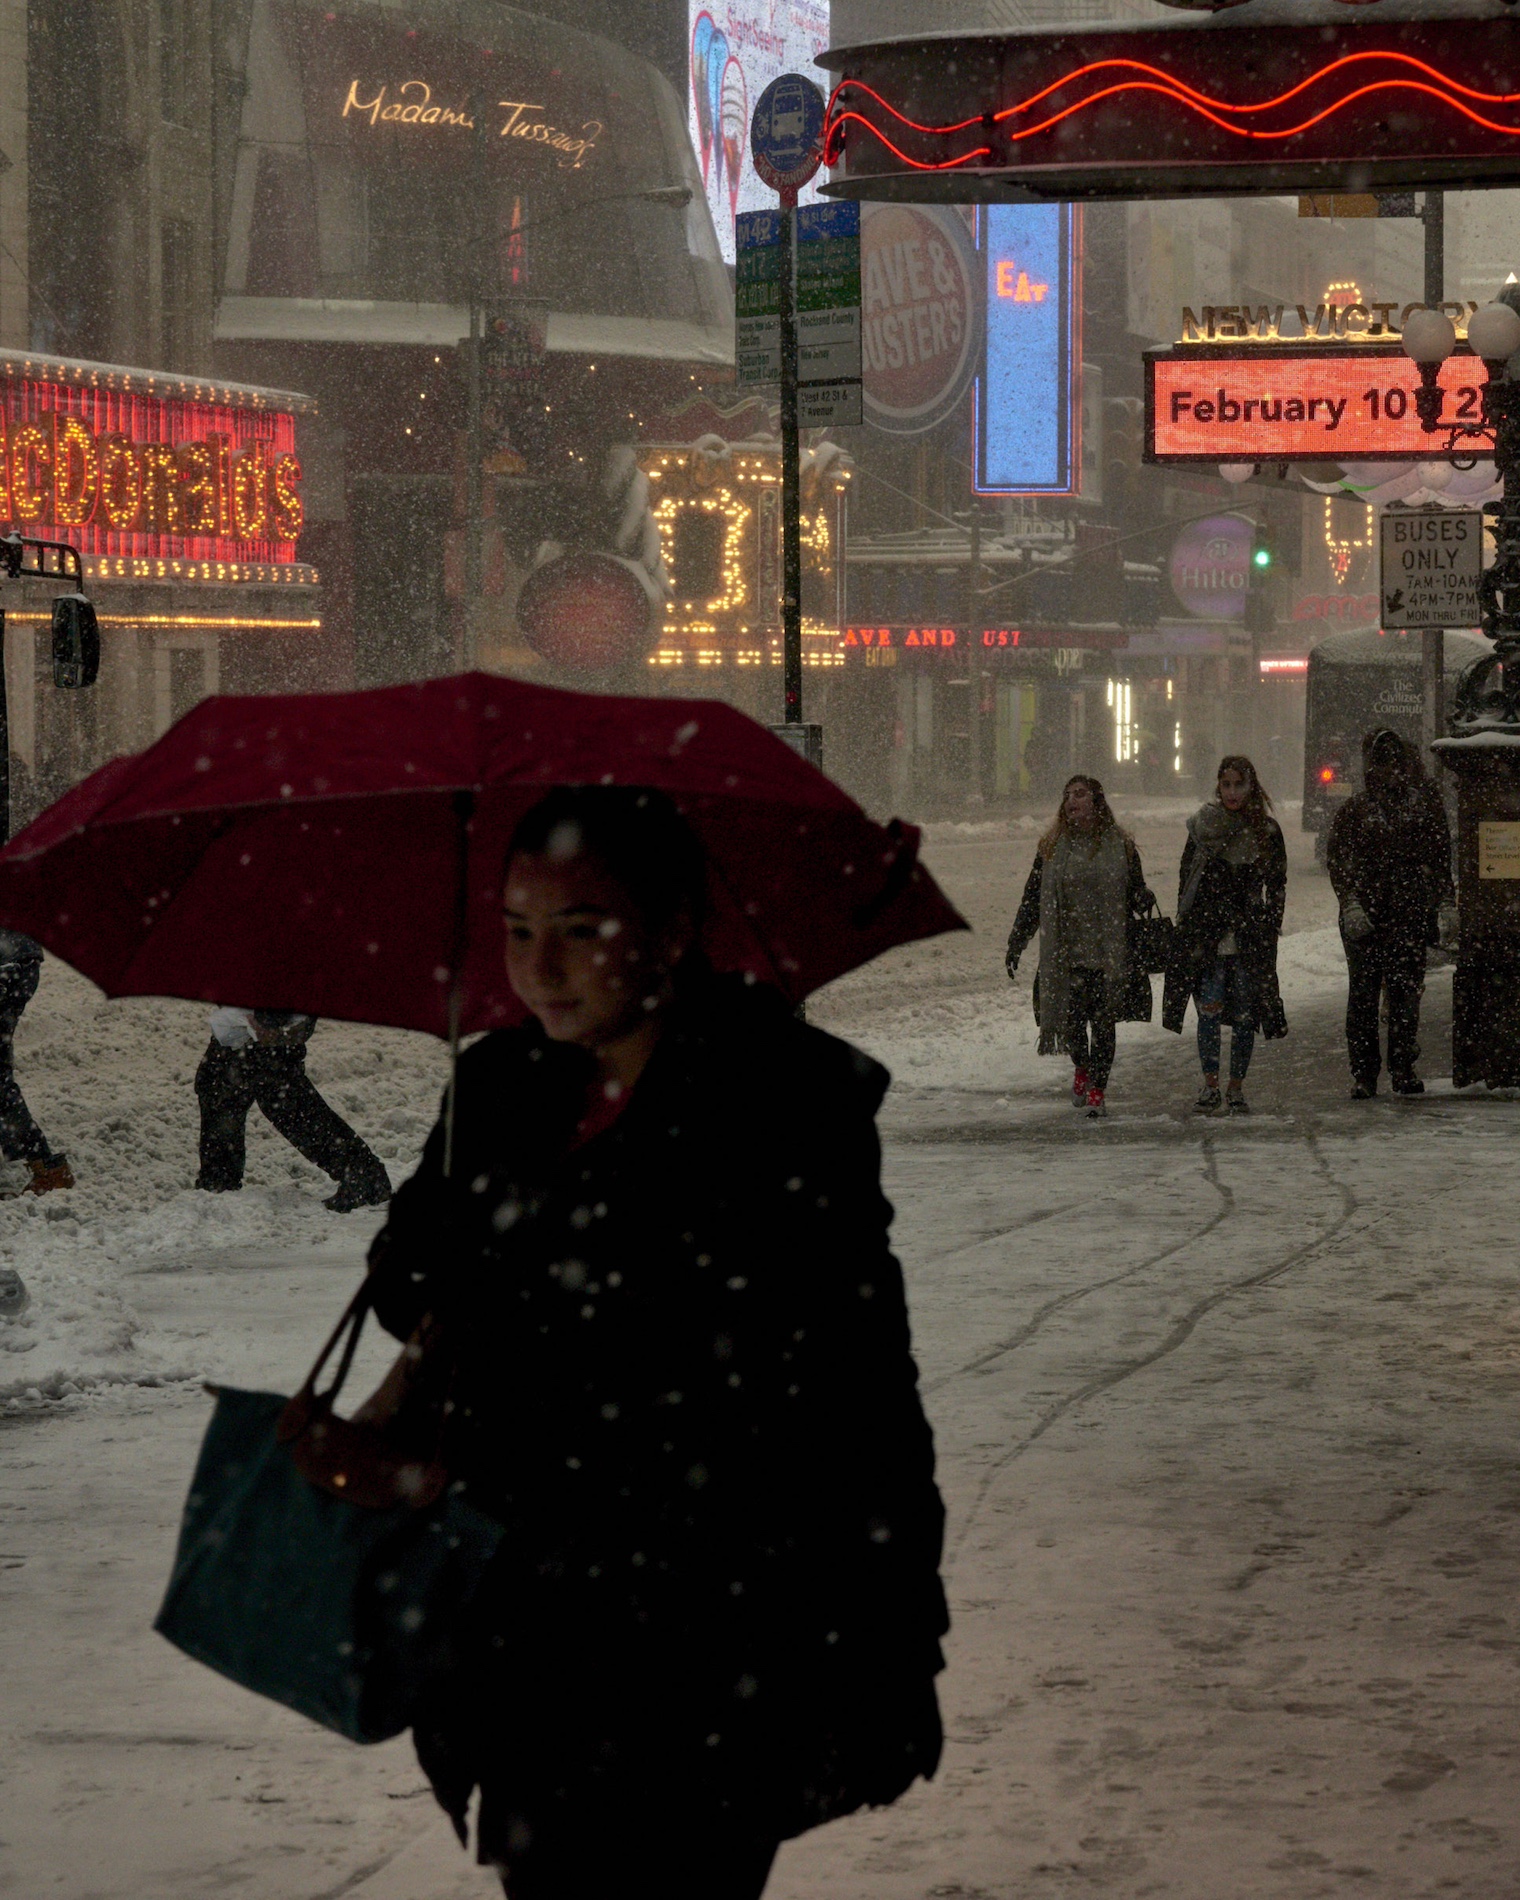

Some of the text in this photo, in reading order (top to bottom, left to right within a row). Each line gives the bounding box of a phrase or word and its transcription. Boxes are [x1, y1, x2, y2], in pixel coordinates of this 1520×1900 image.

[866, 240, 933, 313] AVE
[1182, 300, 1482, 342] NEW VICTR
[832, 390, 840, 401] St
[808, 406, 834, 417] Avenue
[1171, 389, 1348, 430] February
[1363, 387, 1407, 421] 10
[1394, 520, 1468, 543] BUSES
[1402, 548, 1459, 571] ONLY
[1405, 574, 1478, 590] 7AM-10AM
[1292, 594, 1380, 621] amc
[1409, 591, 1476, 607] 4PM-7PM
[1406, 609, 1478, 621] MON THRU FRI
[845, 629, 891, 646] AVE
[905, 629, 956, 646] AND
[1391, 679, 1415, 692] The
